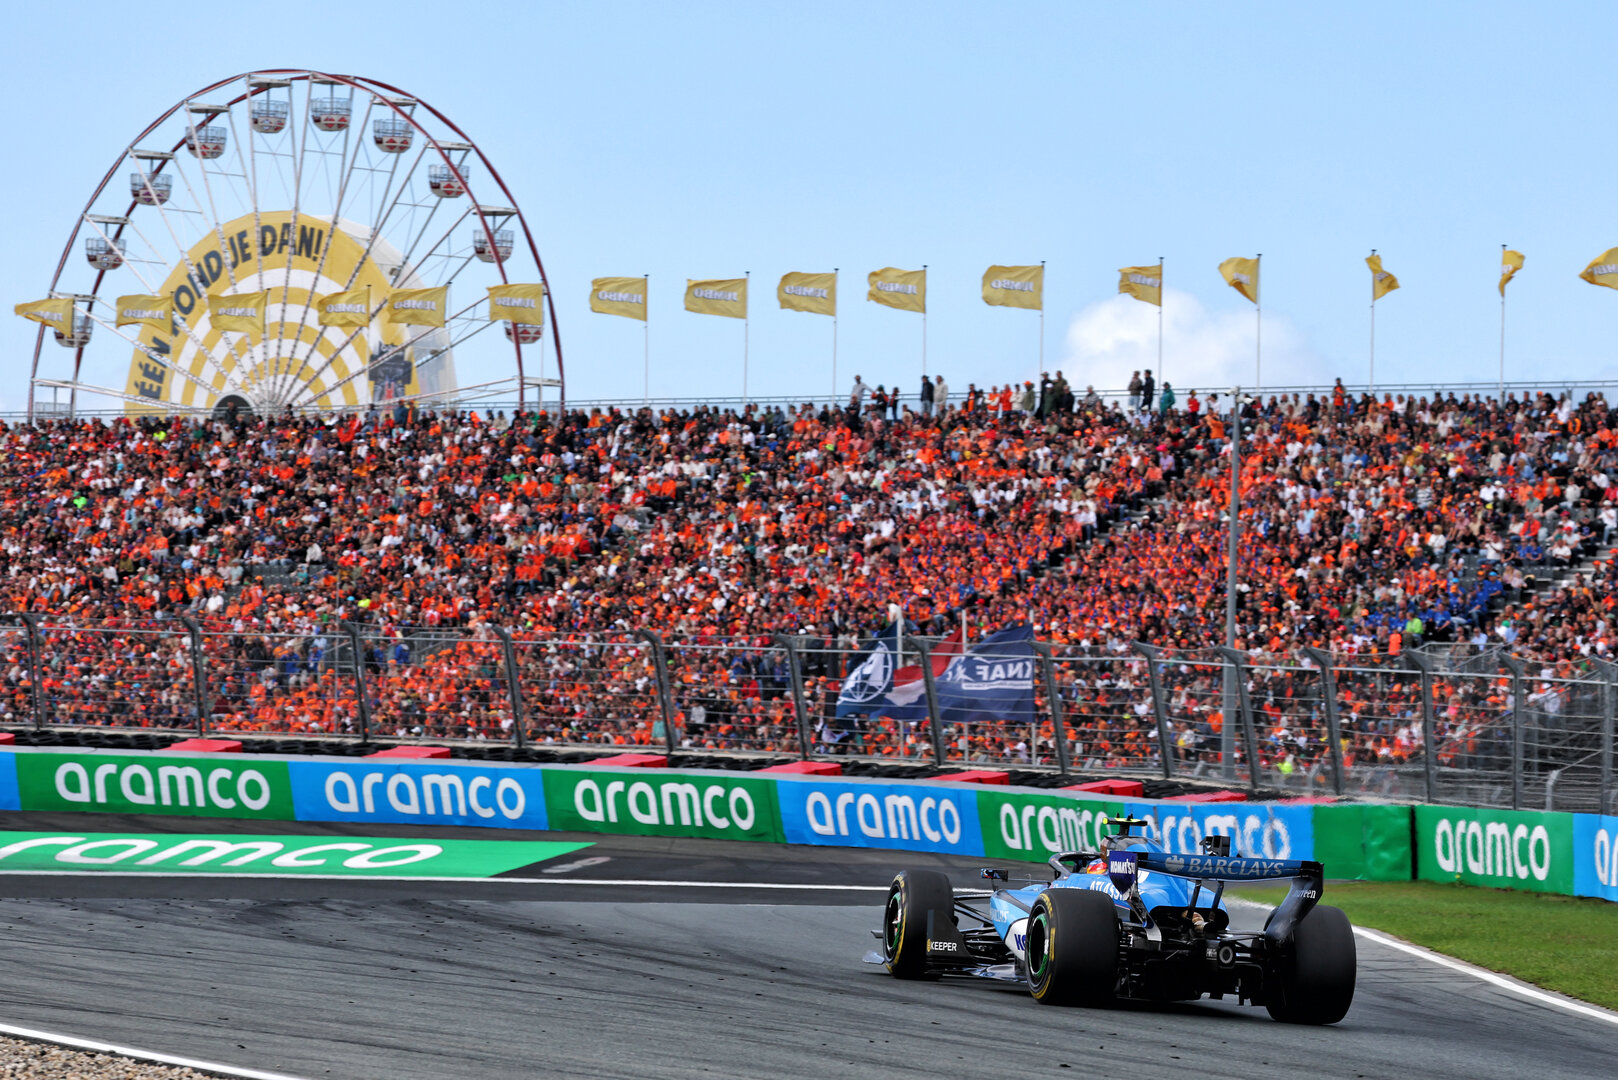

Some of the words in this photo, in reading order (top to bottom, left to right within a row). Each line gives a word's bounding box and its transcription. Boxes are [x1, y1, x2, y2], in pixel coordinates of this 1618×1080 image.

[171, 229, 252, 337] ONDJE
[260, 222, 324, 262] DAN!
[55, 762, 271, 810] aramco
[325, 771, 526, 820] aramco
[574, 779, 755, 830] aramco
[806, 791, 961, 844] aramco
[1000, 803, 1112, 854] aramco
[0, 837, 444, 868] ramco
[1187, 857, 1285, 876] BARCLAYS
[1435, 819, 1551, 881] aramco
[930, 941, 958, 952] KEEPER
